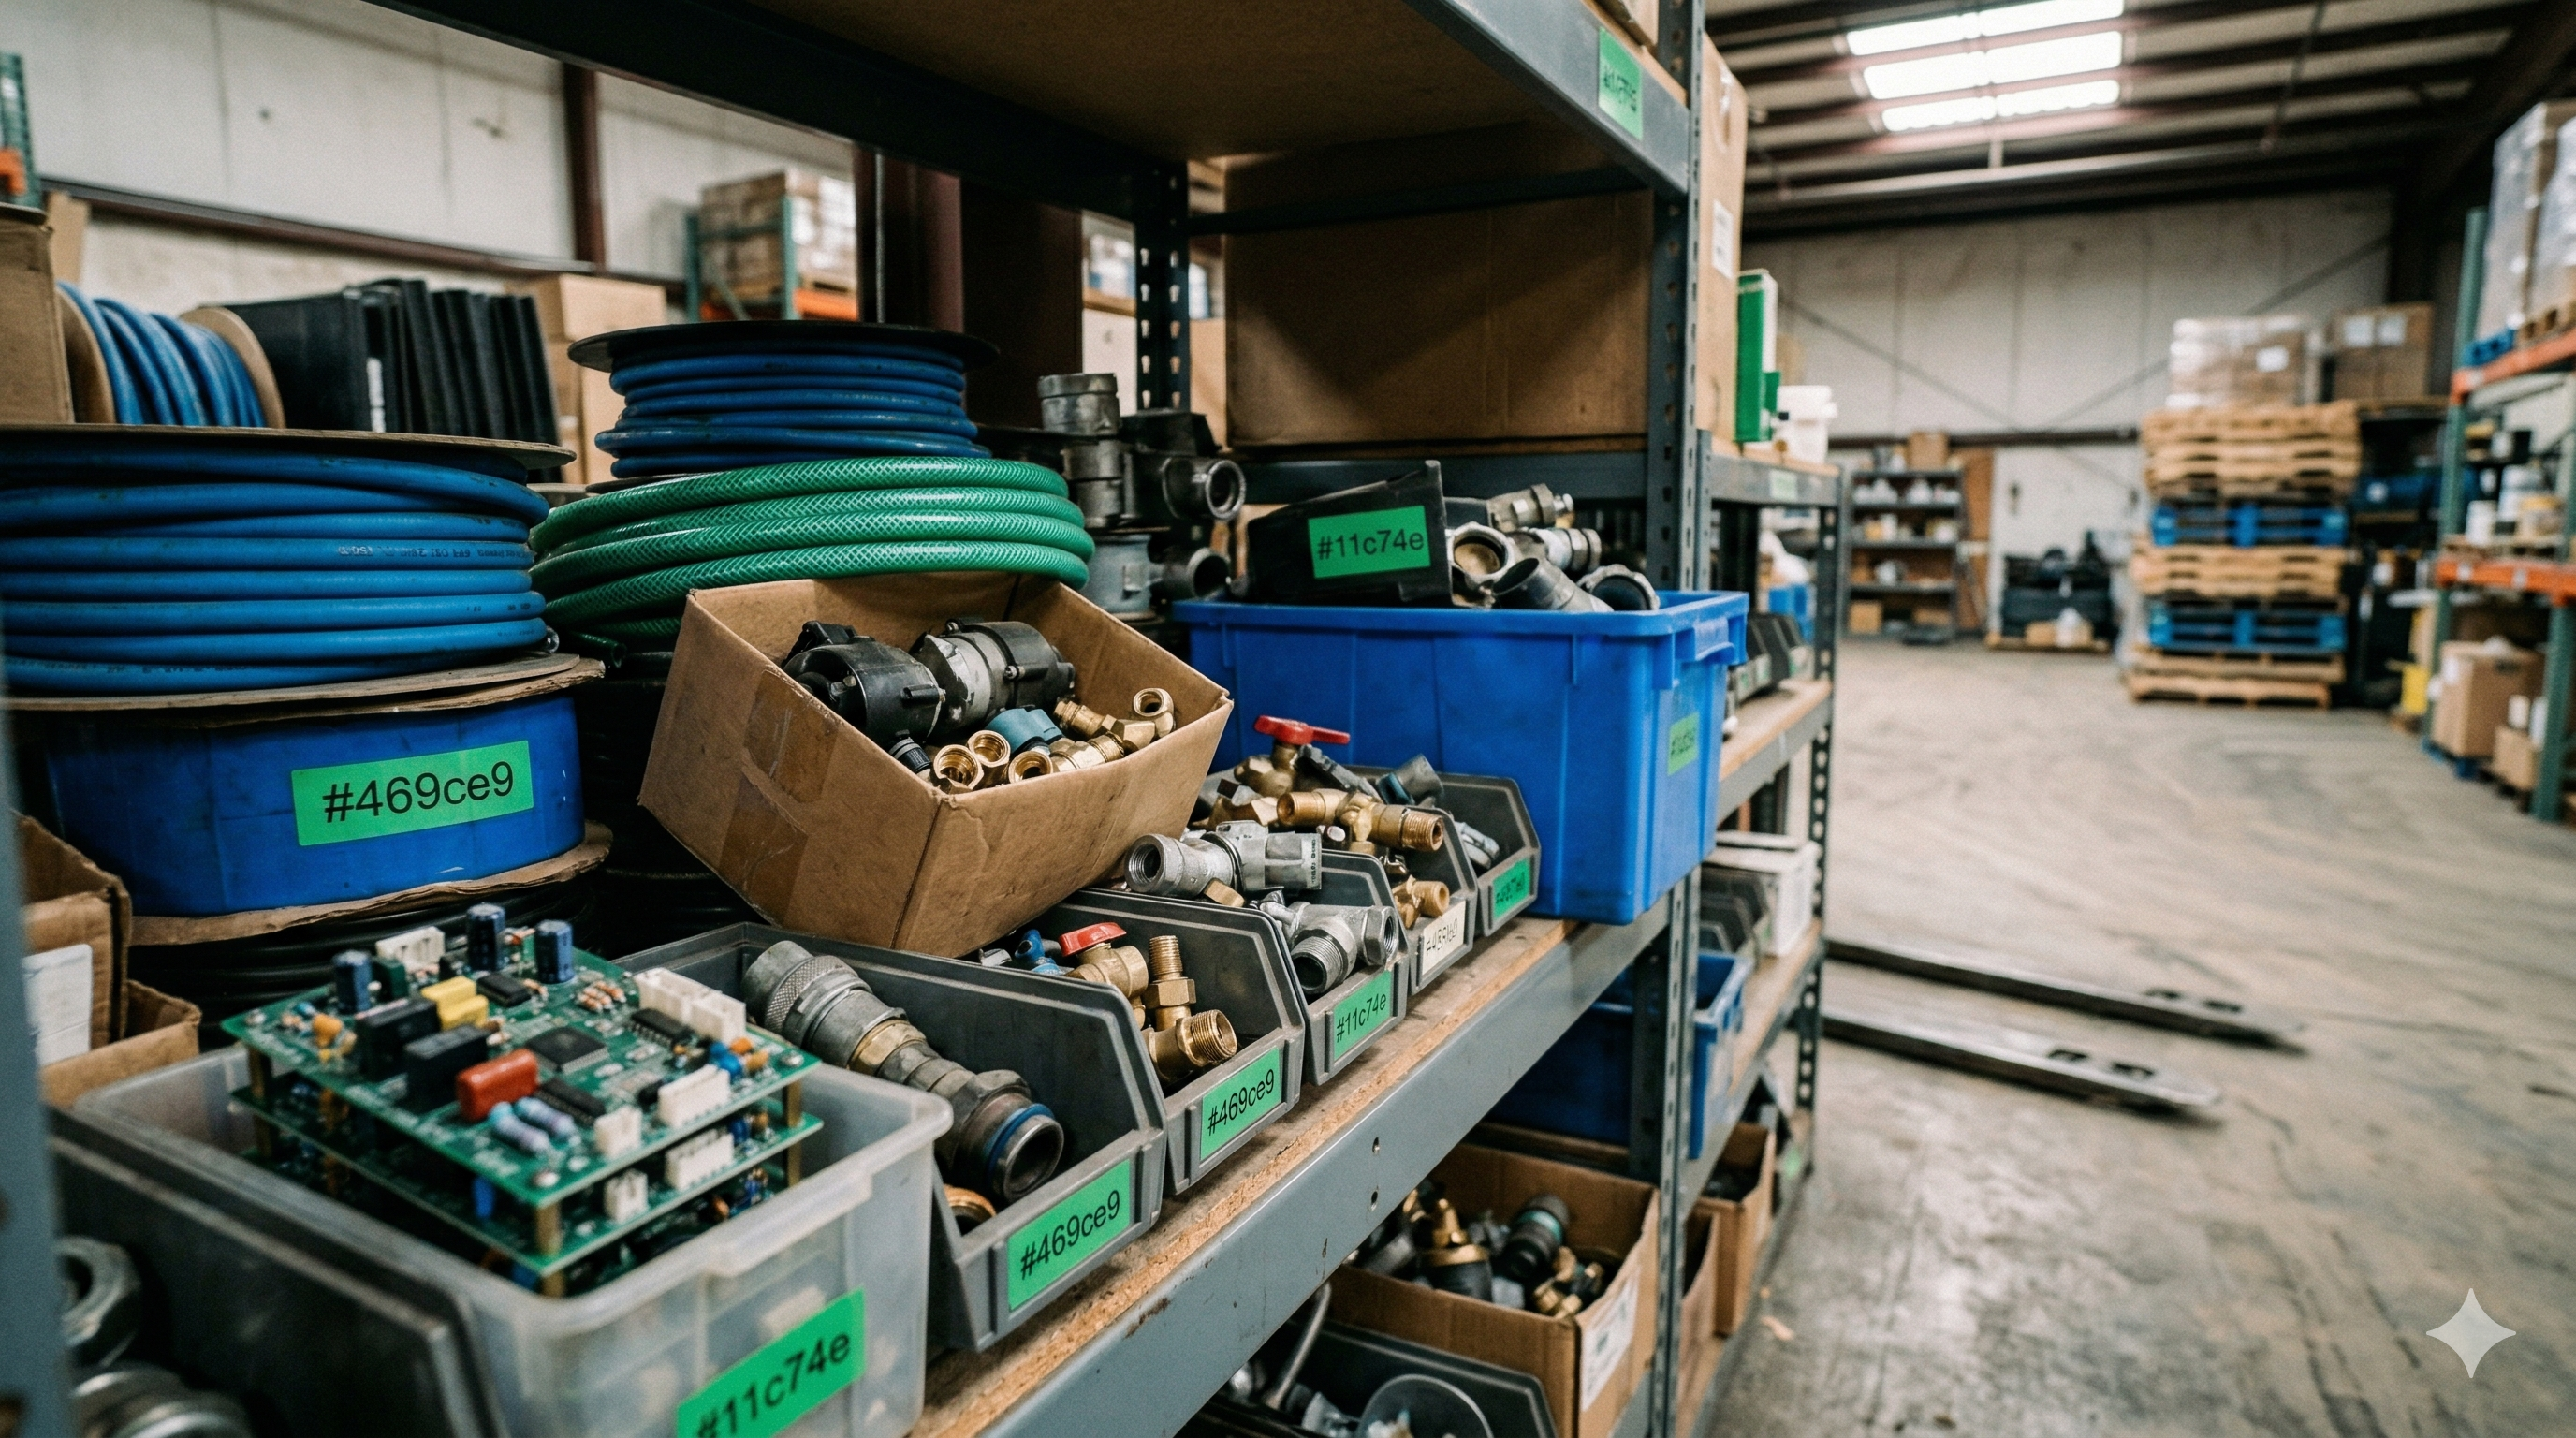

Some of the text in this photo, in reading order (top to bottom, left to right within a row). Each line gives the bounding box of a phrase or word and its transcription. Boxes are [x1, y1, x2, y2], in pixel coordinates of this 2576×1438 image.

[1317, 528, 1424, 560] #11c74e
[322, 760, 514, 823] #469ce9
[1336, 993, 1387, 1043] #11c74e
[1208, 1068, 1275, 1136] #469ce9
[1020, 1189, 1120, 1280] #469ce9
[697, 1332, 851, 1438] #11c74e
